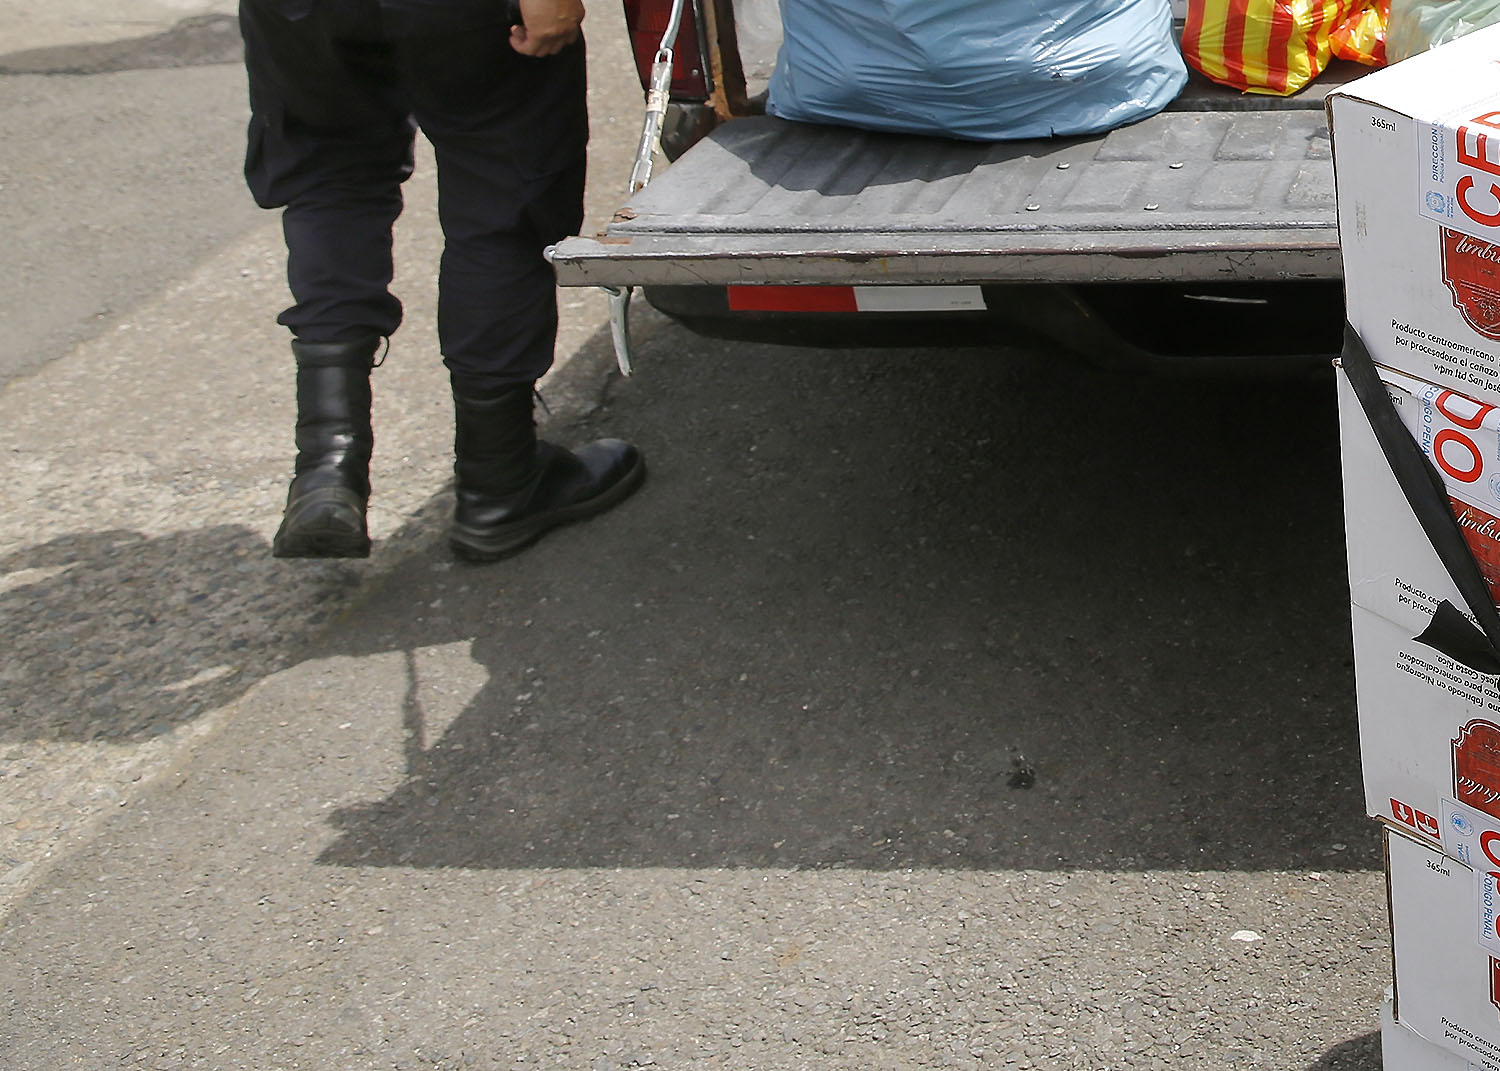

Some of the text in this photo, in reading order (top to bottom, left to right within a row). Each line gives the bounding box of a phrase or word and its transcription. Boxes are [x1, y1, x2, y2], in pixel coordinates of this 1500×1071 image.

[1371, 116, 1396, 132] 365ml
[1391, 319, 1426, 339] Producto
[1427, 332, 1495, 362] centroamericano
[1395, 335, 1409, 346] por
[1410, 341, 1458, 364] procesadora
[1460, 357, 1468, 367] el
[1467, 373, 1484, 387] San
[1394, 577, 1427, 600] Producto
[1398, 593, 1411, 605] por
[1399, 651, 1463, 684] comercializadora
[1455, 665, 1479, 680] Costa
[1396, 662, 1484, 707] fabricado en Nicaragua
[1464, 680, 1483, 694] para
[1426, 860, 1451, 876] 365ml
[1480, 908, 1493, 940] PENAL)
[1440, 1016, 1474, 1039] Producto
[1444, 1029, 1458, 1041] por
